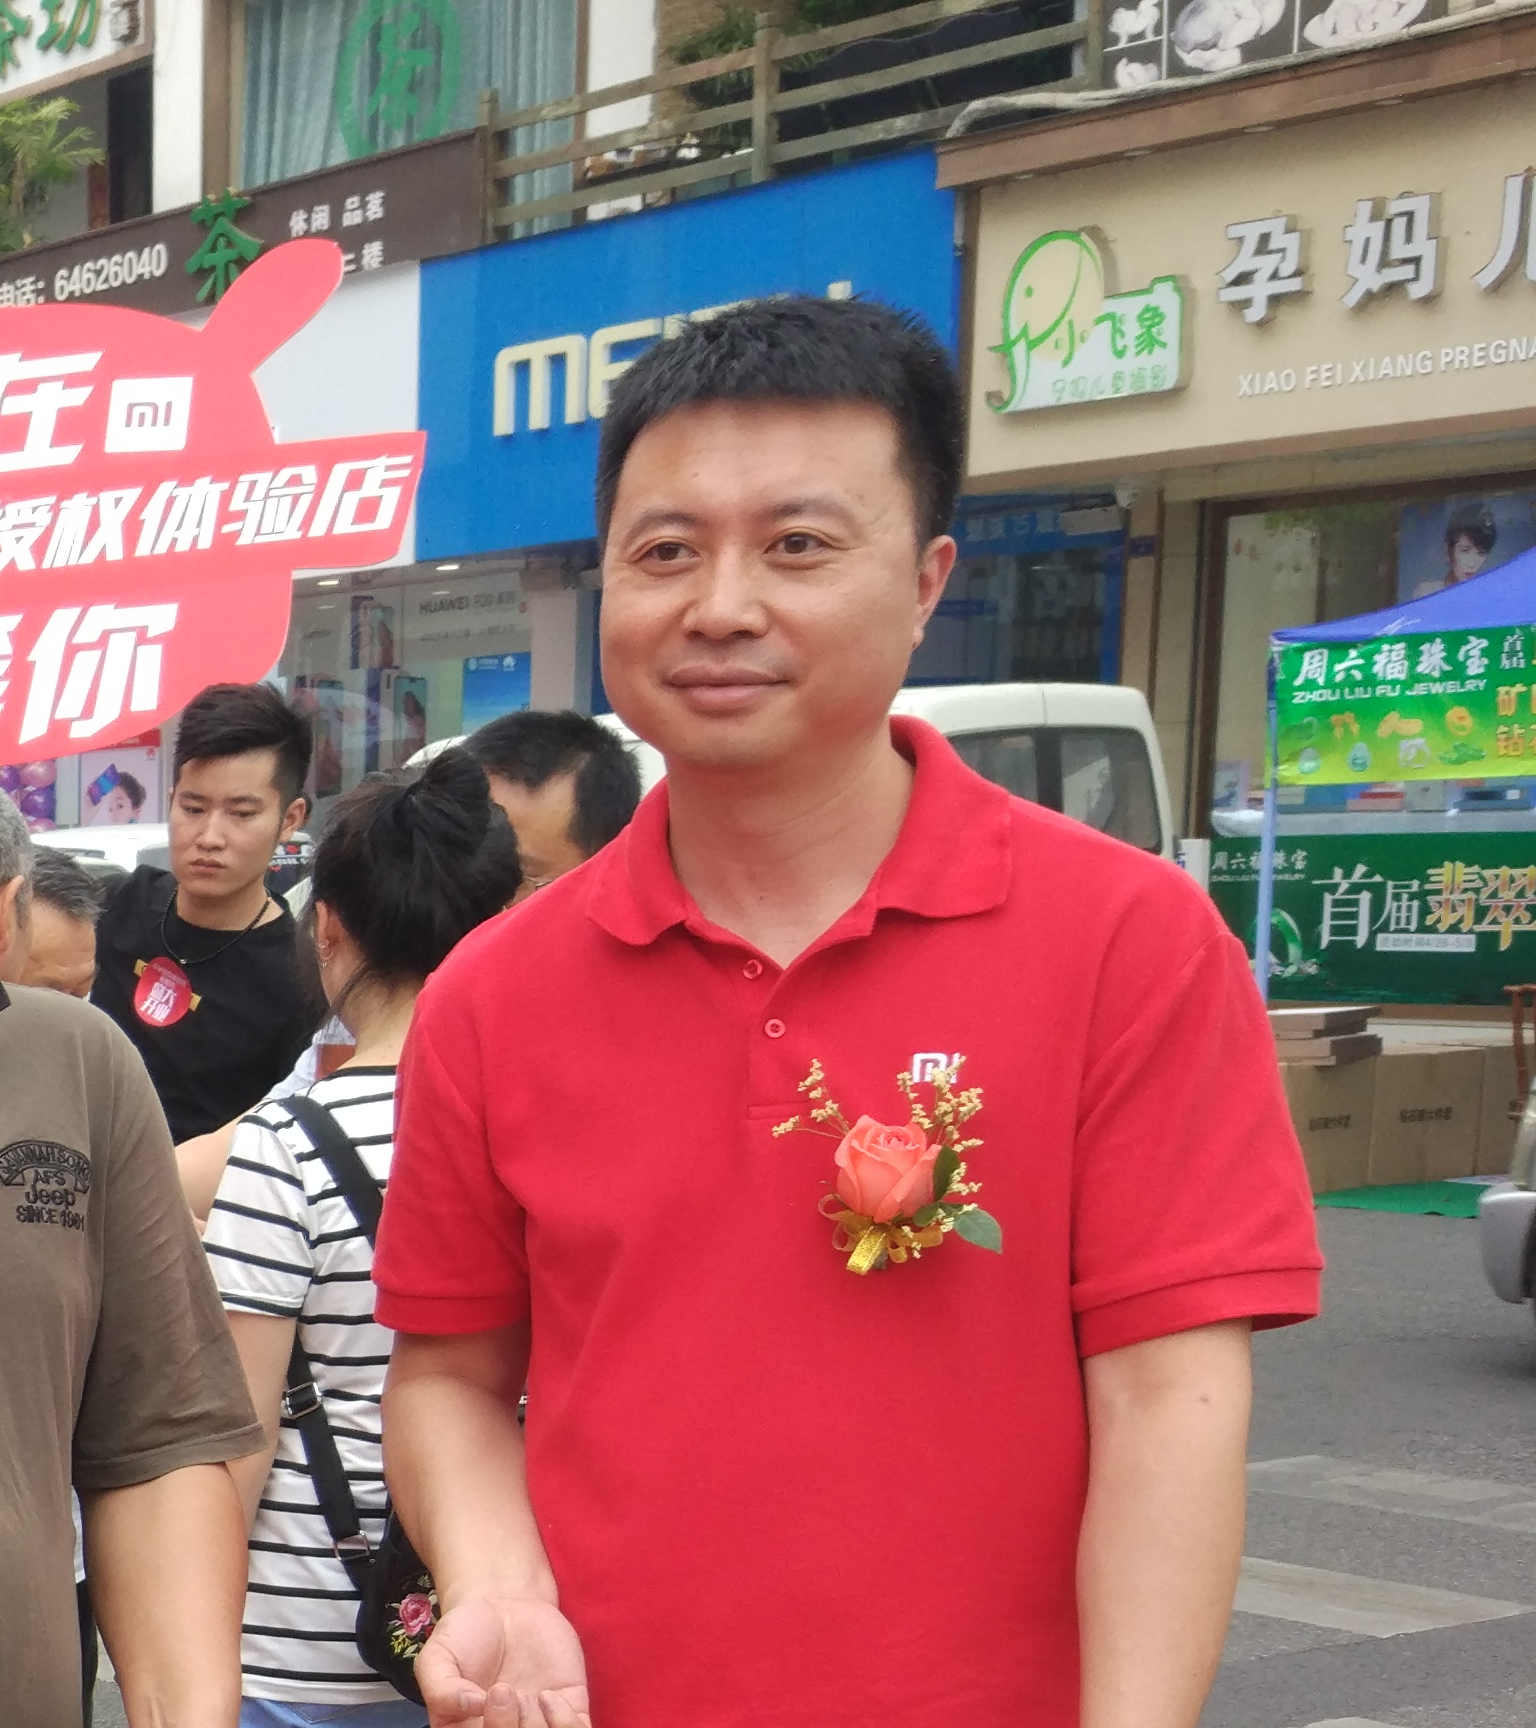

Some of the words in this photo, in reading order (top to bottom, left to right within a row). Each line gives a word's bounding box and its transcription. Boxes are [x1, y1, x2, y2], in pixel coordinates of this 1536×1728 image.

[185, 187, 264, 303] 茶
[54, 243, 169, 302] 64626040
[1238, 368, 1297, 398] XIAO
[1304, 363, 1344, 390] FEI
[1348, 349, 1433, 384] XIANG
[1292, 635, 1490, 687] 周六福珠宝
[1291, 688, 1340, 705] ZHOU
[1405, 679, 1488, 697] JEWELRY
[24, 1184, 76, 1209] Jeep
